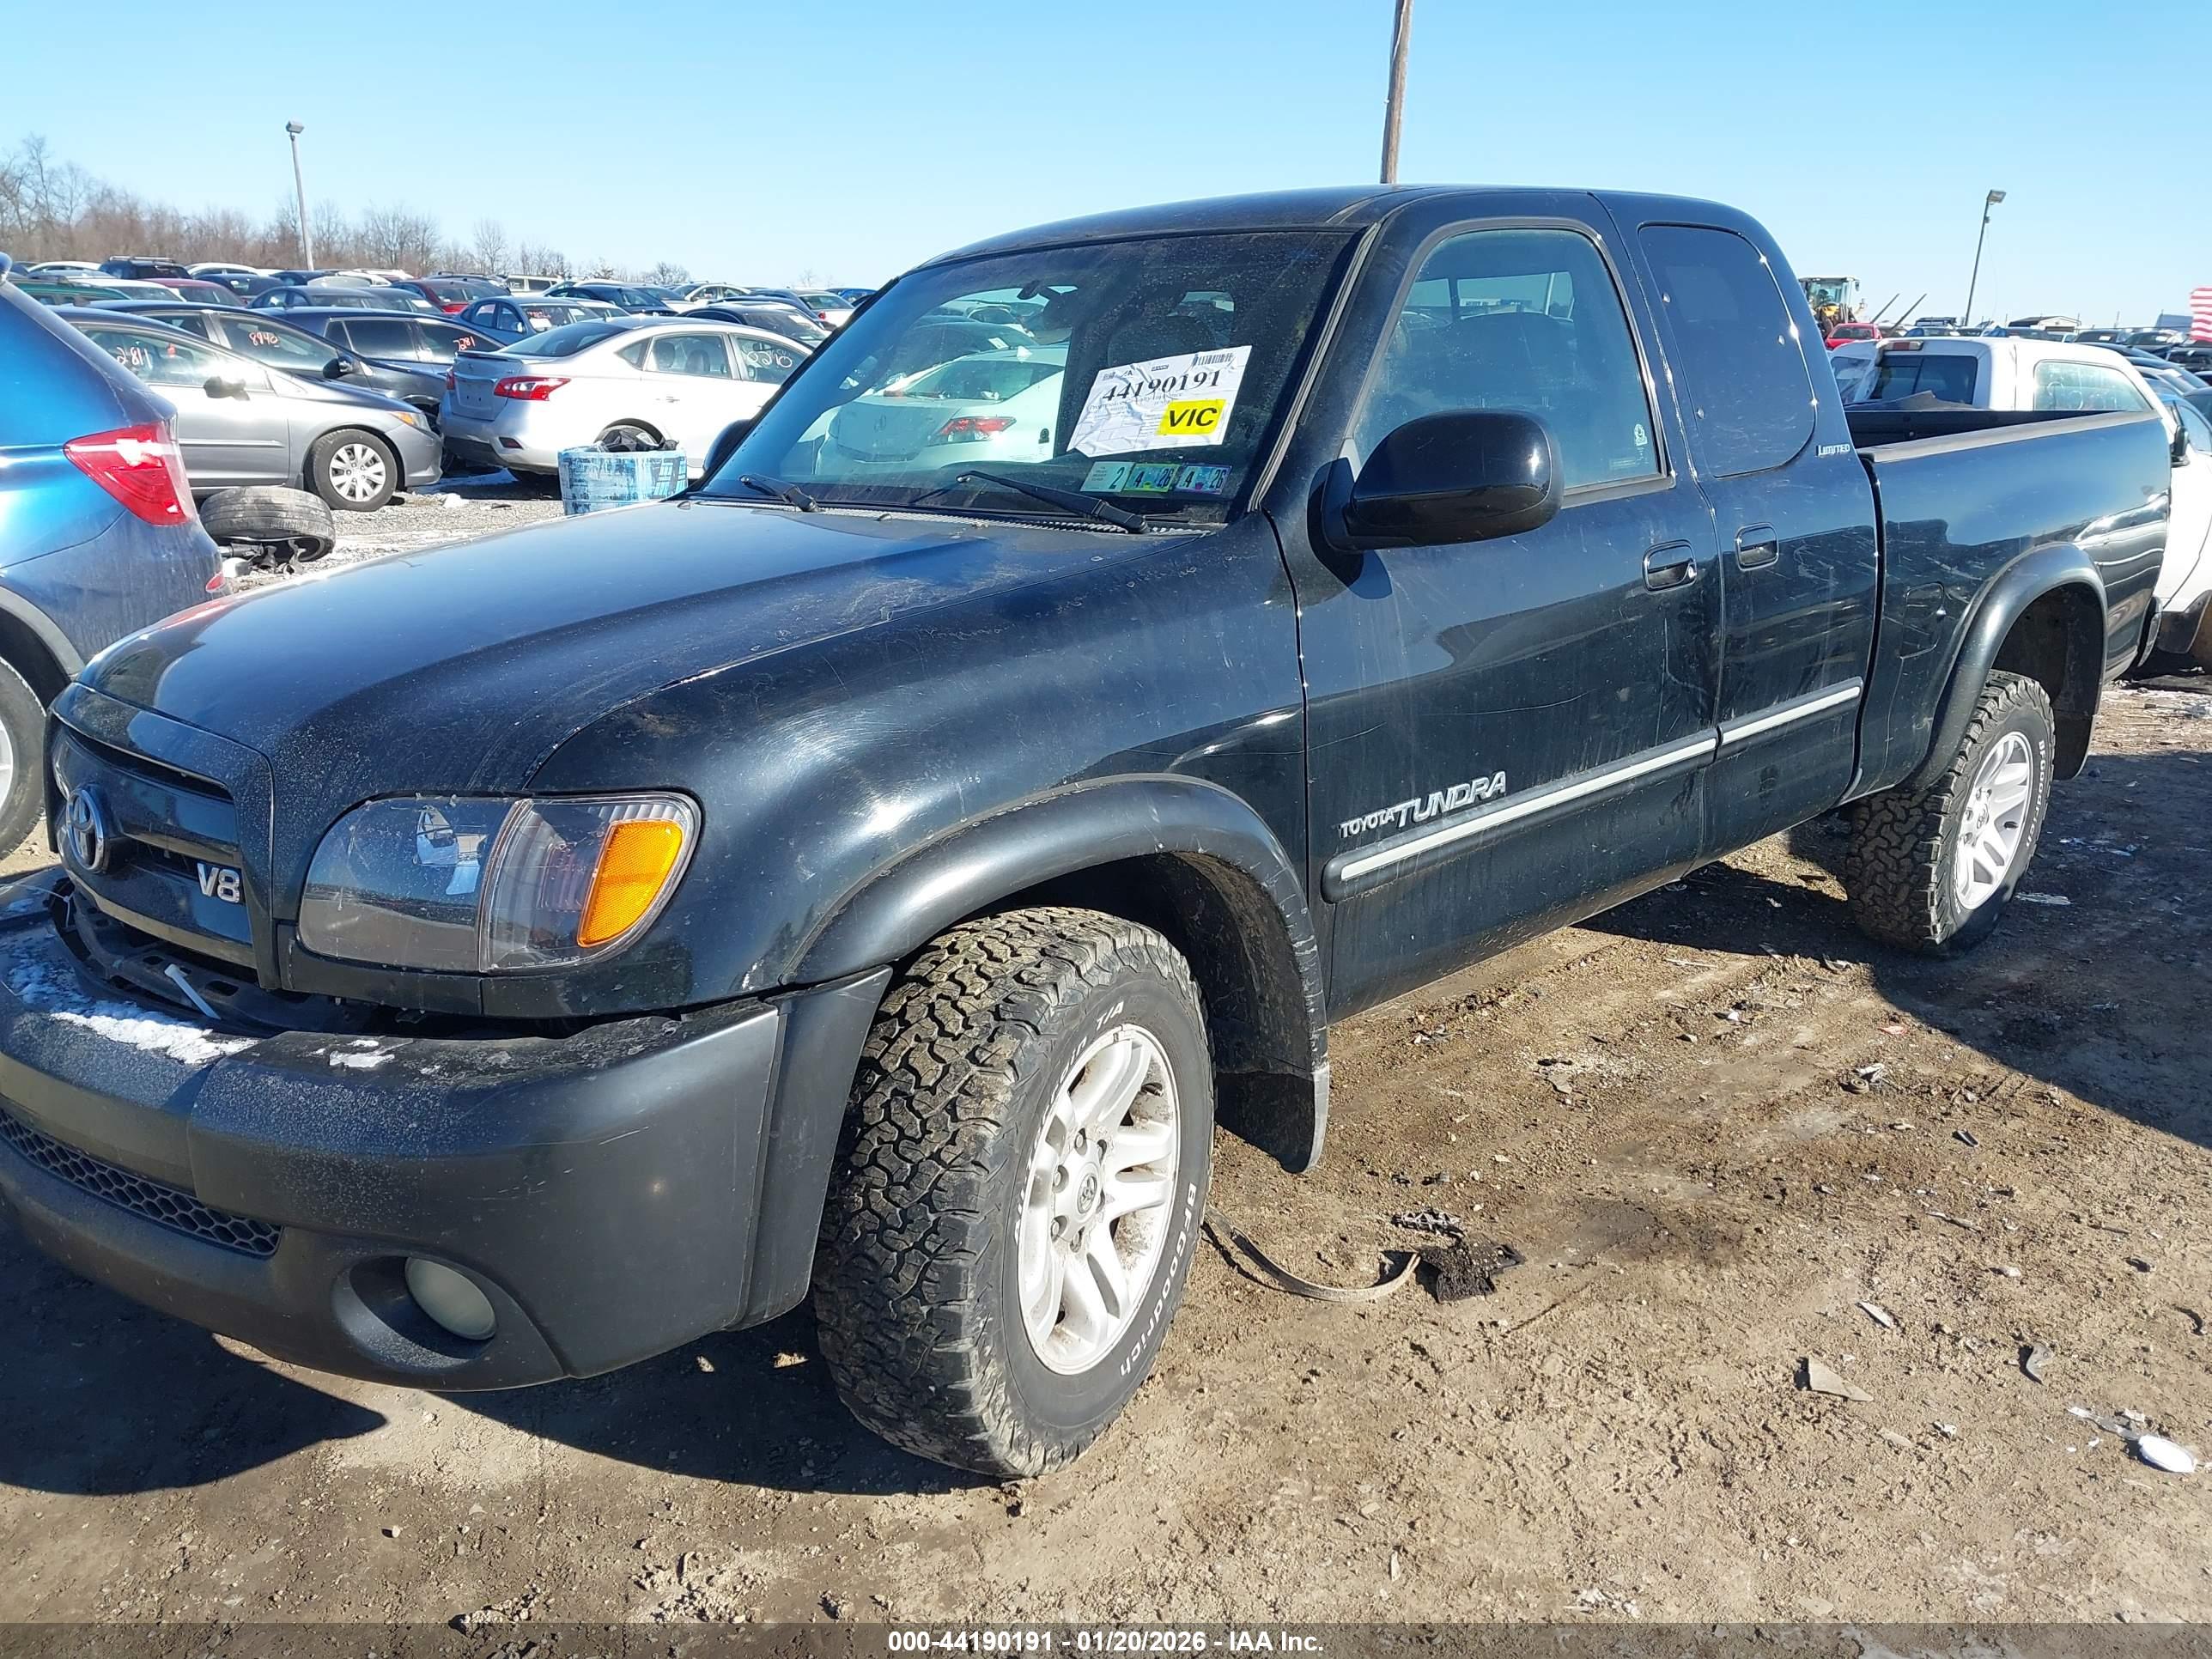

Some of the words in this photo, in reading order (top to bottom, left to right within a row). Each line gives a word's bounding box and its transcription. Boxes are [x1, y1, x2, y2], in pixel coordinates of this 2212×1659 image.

[1103, 369, 1221, 403] 44190191
[1169, 407, 1218, 428] VIC
[1818, 443, 1850, 456] LIMITED
[1109, 466, 1124, 489] 2
[1340, 809, 1395, 838] TOYOTA
[1393, 770, 1506, 828] TUNDRA
[197, 862, 240, 903] V8
[1097, 1001, 1124, 1031] T/A
[1119, 1182, 1197, 1378] BFGoodrich
